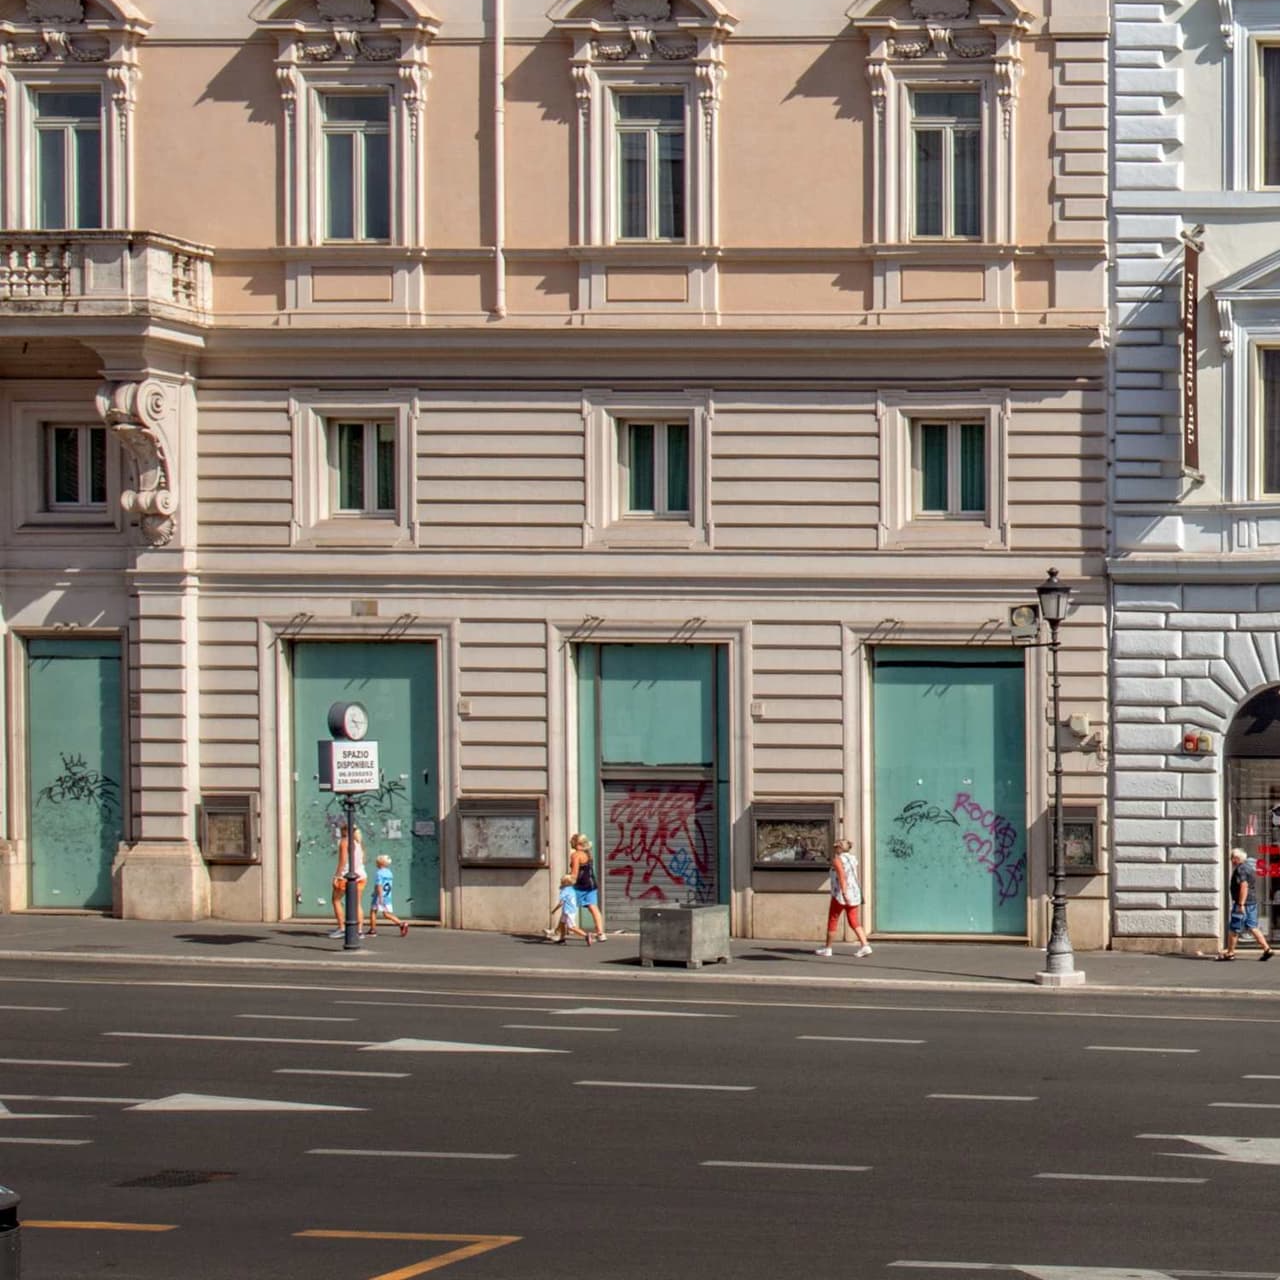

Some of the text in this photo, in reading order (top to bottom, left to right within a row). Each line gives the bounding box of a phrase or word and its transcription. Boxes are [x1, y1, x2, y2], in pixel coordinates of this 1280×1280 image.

[1186, 272, 1196, 445] The Glam Hotel
[342, 750, 369, 759] SPAZIO
[336, 760, 375, 769] DISPONIBILE
[383, 882, 392, 898] 9
